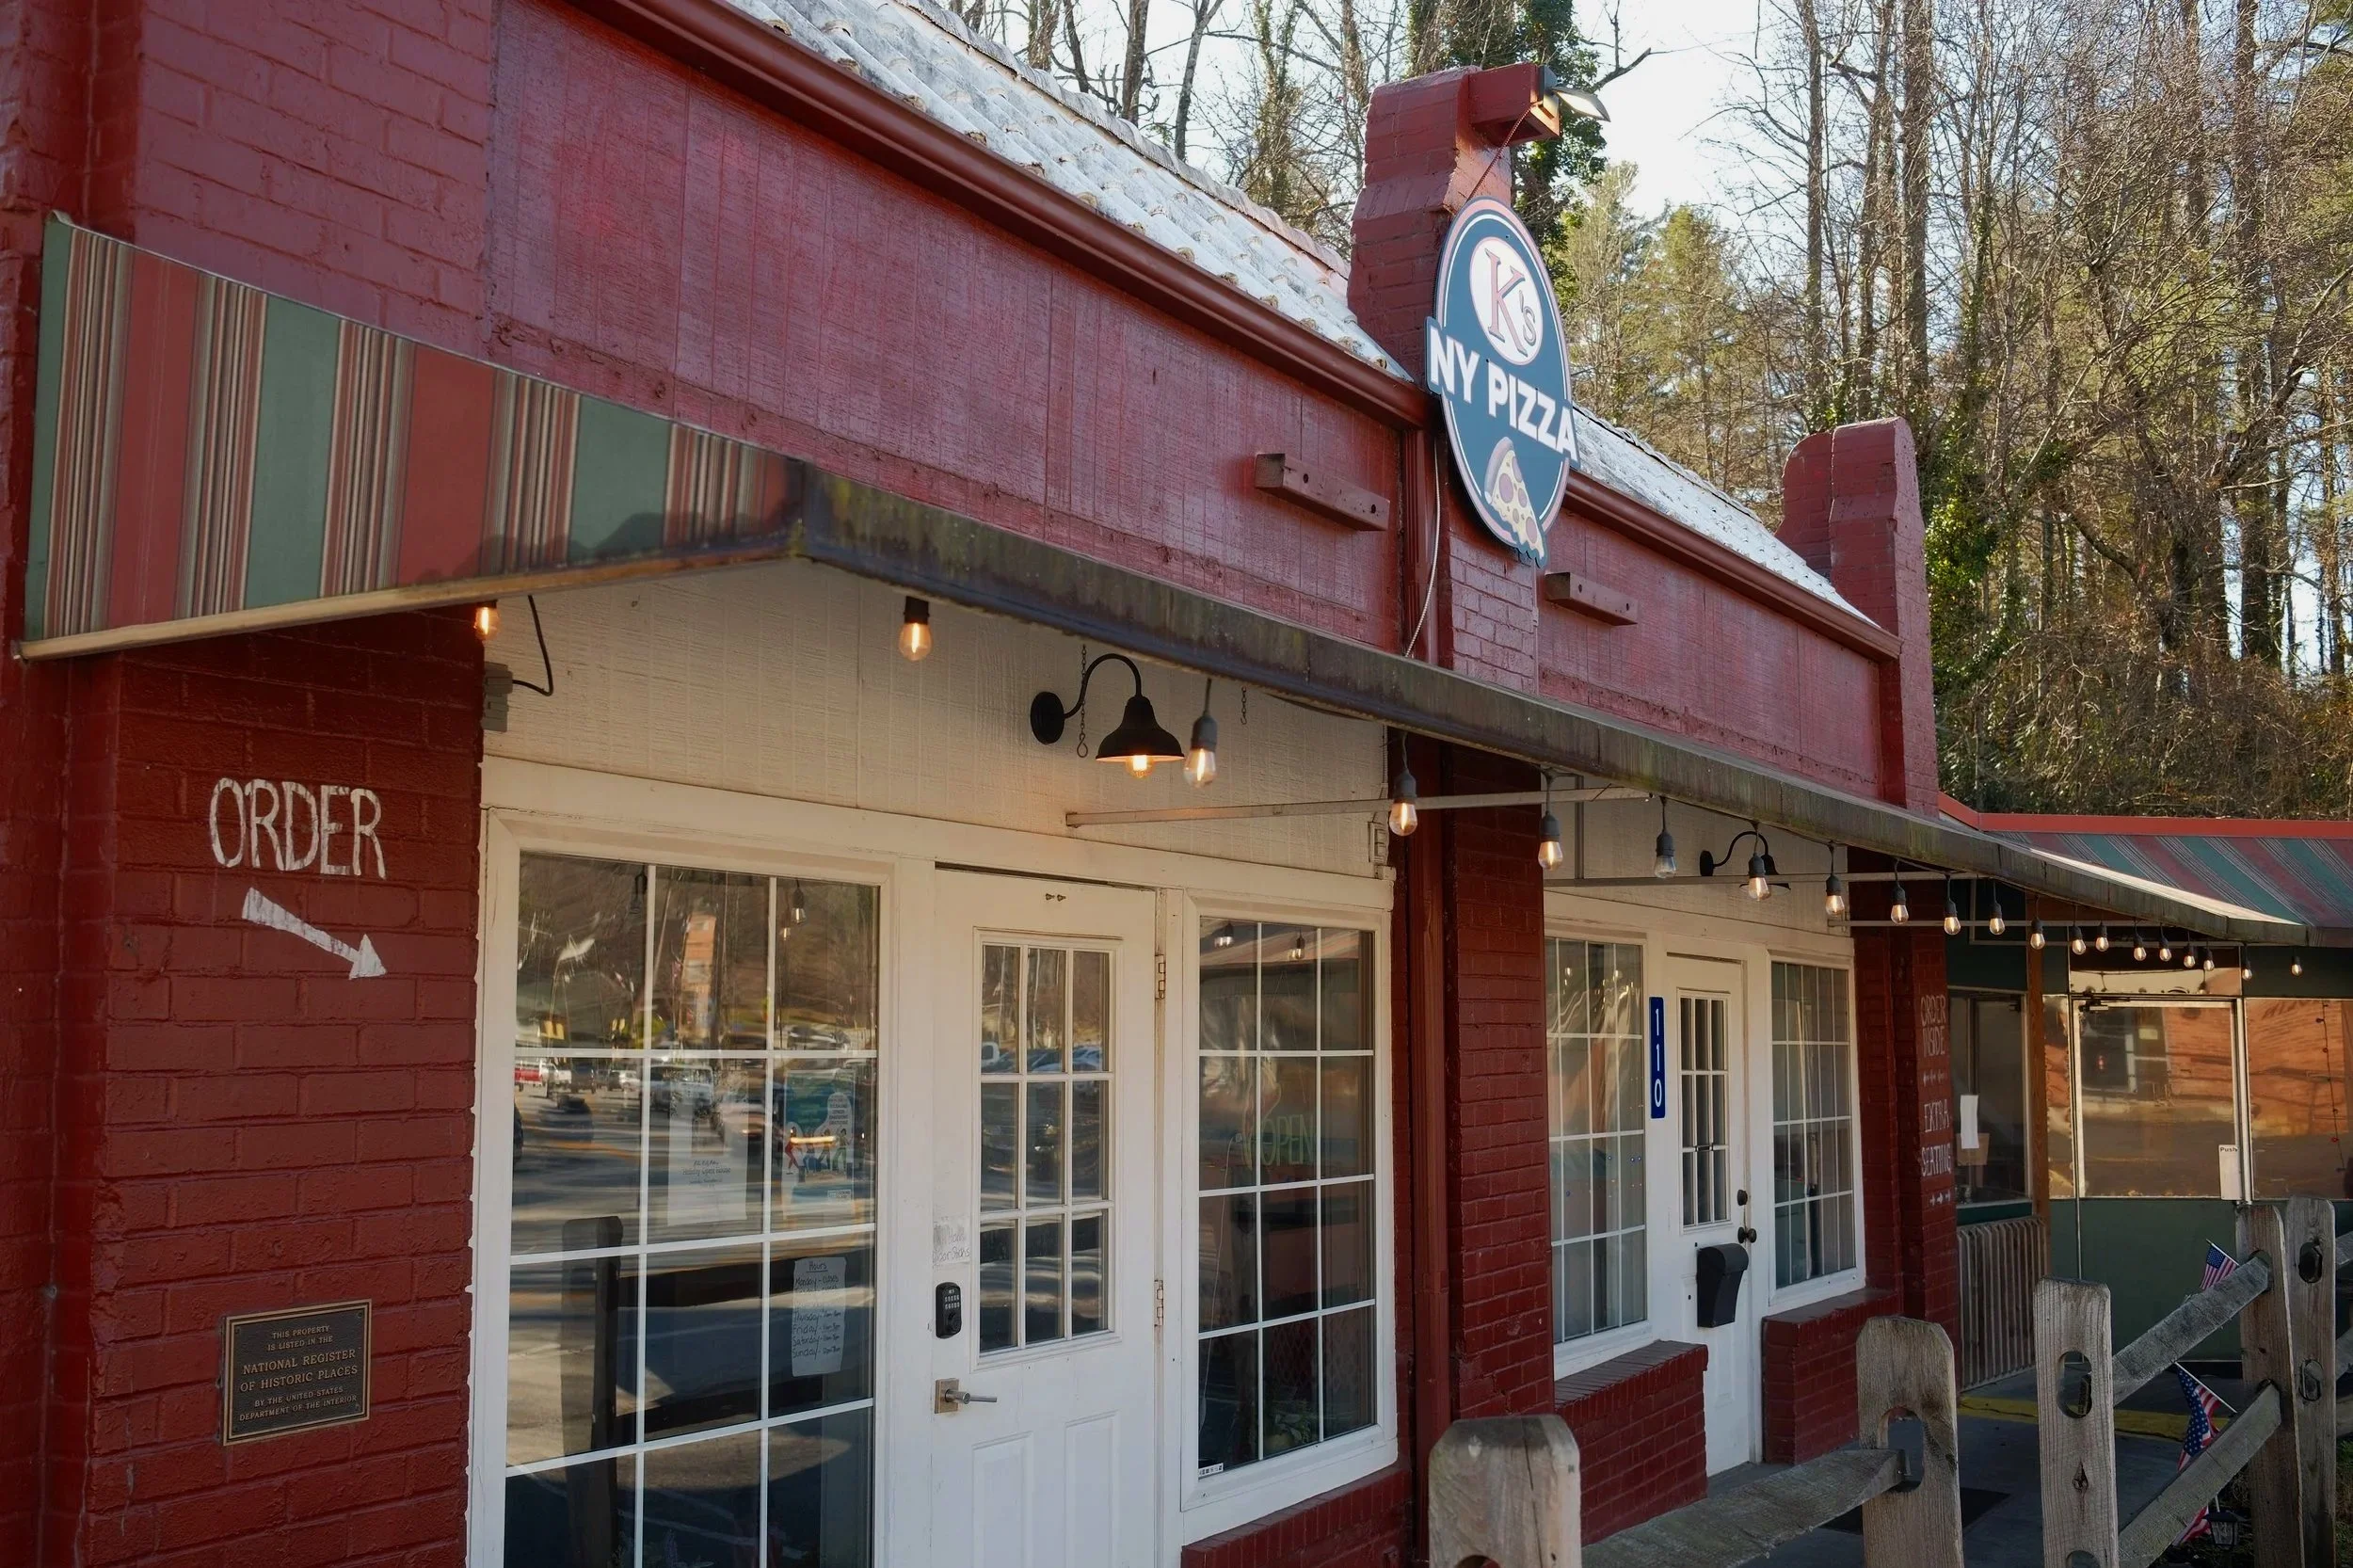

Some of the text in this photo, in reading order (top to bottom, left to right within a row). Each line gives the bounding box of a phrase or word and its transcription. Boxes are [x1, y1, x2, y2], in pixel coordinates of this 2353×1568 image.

[1484, 248, 1536, 359] K's
[1430, 325, 1579, 462] NY PIZZA
[209, 776, 387, 880] ORDER
[1920, 995, 1946, 1027] ORDER
[1654, 1008, 1662, 1108] 110
[1924, 1098, 1950, 1132] EXTRA
[1921, 1143, 1952, 1176] SEATING
[267, 1335, 333, 1352] IS LISTED IN THE
[272, 1325, 329, 1339] THIS PROPERTY
[243, 1349, 356, 1374] NATIONAL REGISTER
[240, 1365, 358, 1392] OF HISTORIC PLACES
[267, 1396, 283, 1404] THE
[286, 1391, 313, 1401] UNITED
[316, 1385, 344, 1397] STATES
[239, 1394, 358, 1421] DEPARTMENT OF THE INTERIOR
